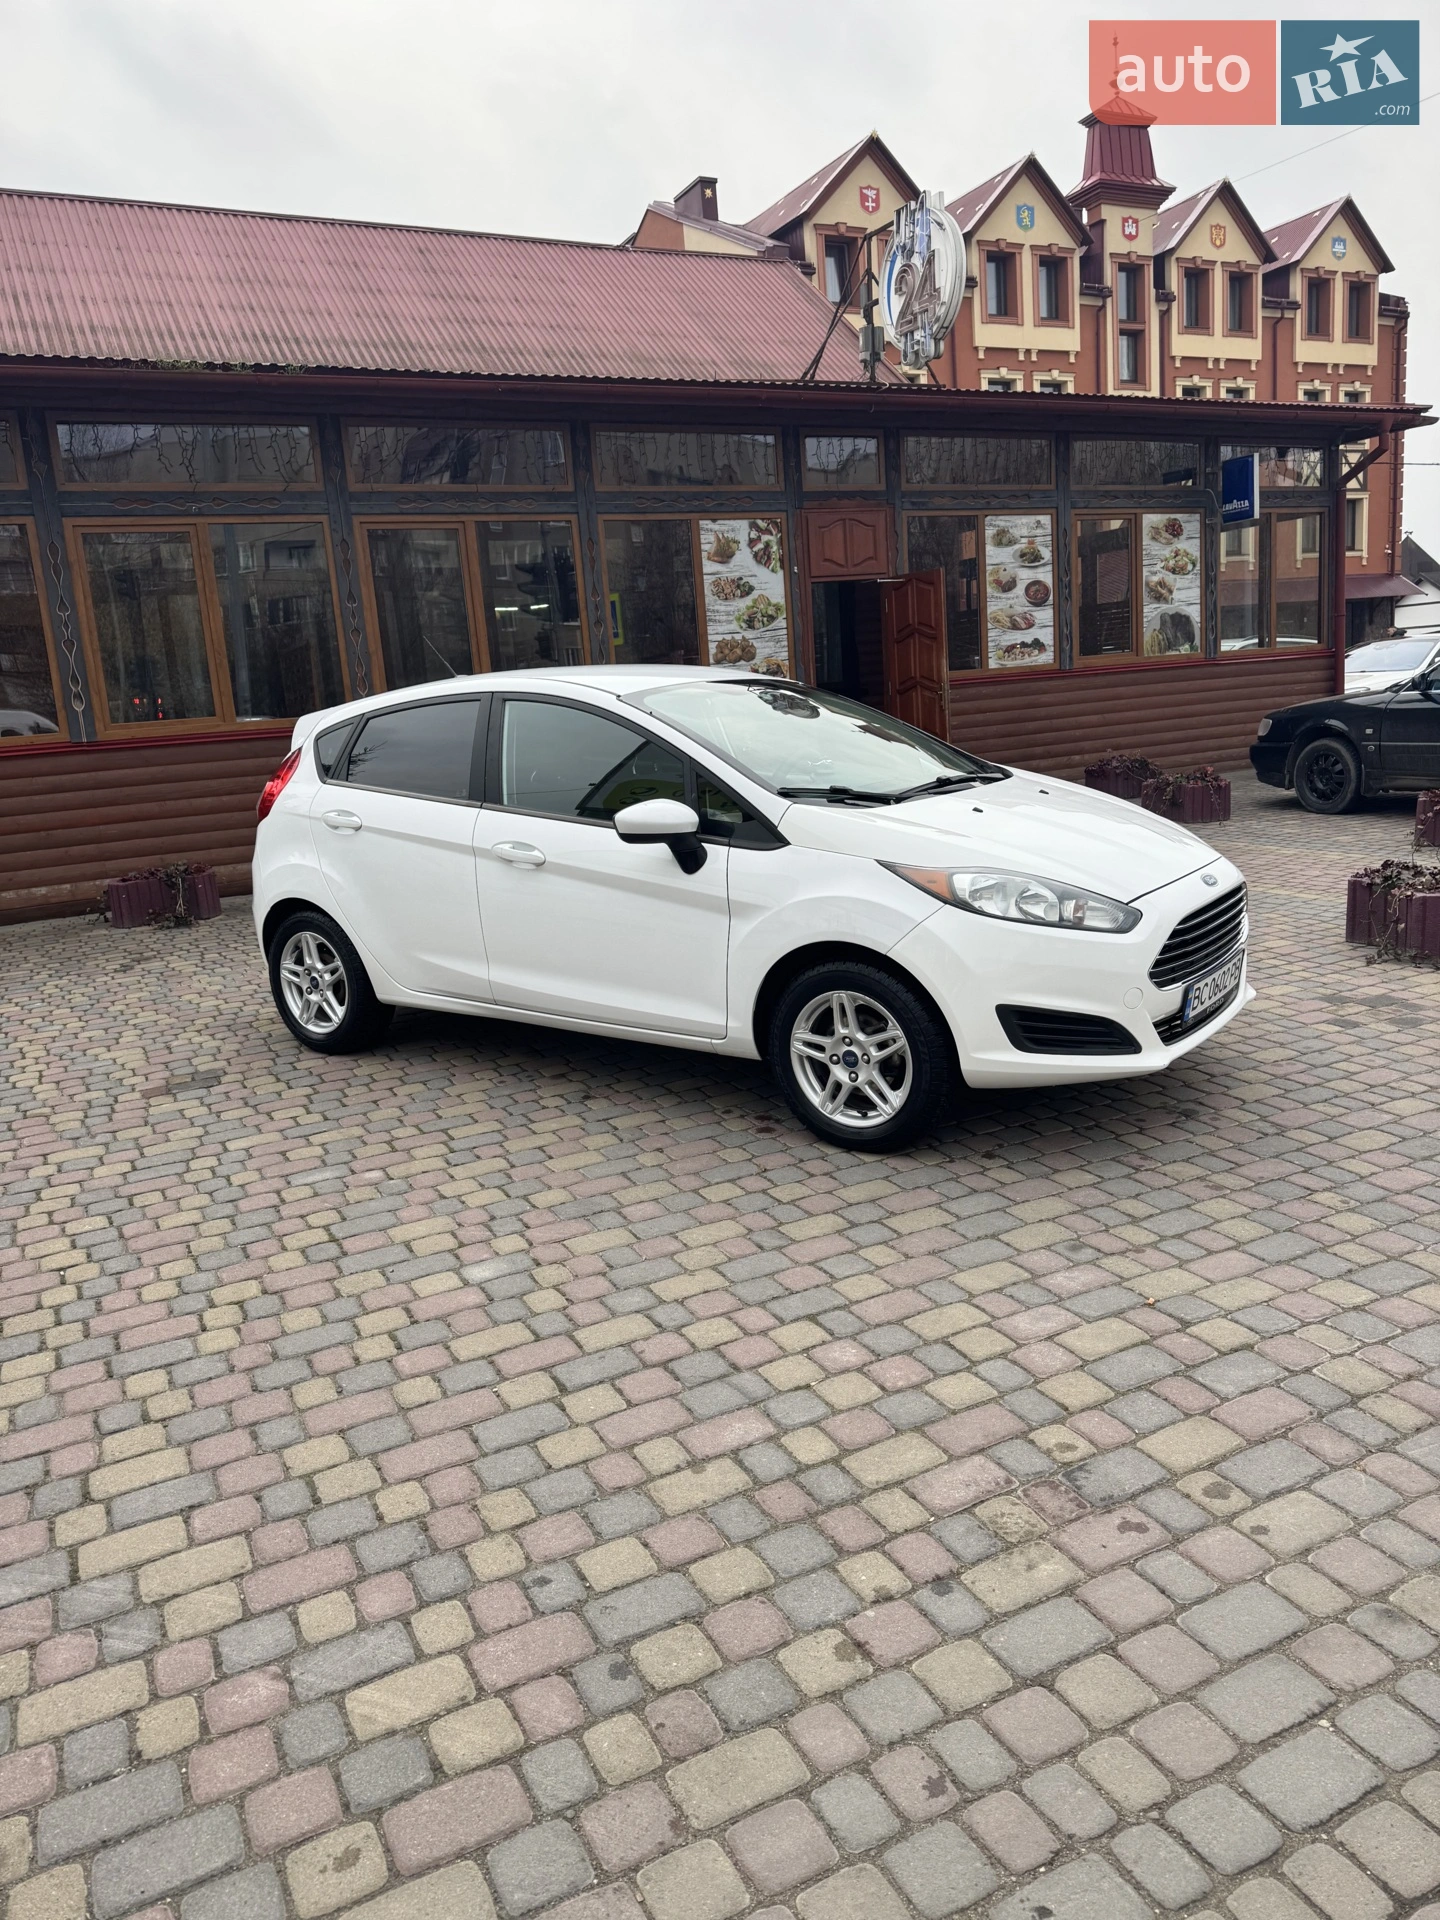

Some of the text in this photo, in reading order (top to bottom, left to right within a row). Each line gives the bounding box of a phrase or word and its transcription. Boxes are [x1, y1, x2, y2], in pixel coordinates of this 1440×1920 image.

[894, 249, 941, 337] 24
[1191, 982, 1209, 1012] BC
[1208, 966, 1231, 1001] 0602
[1206, 998, 1225, 1014] FORD
